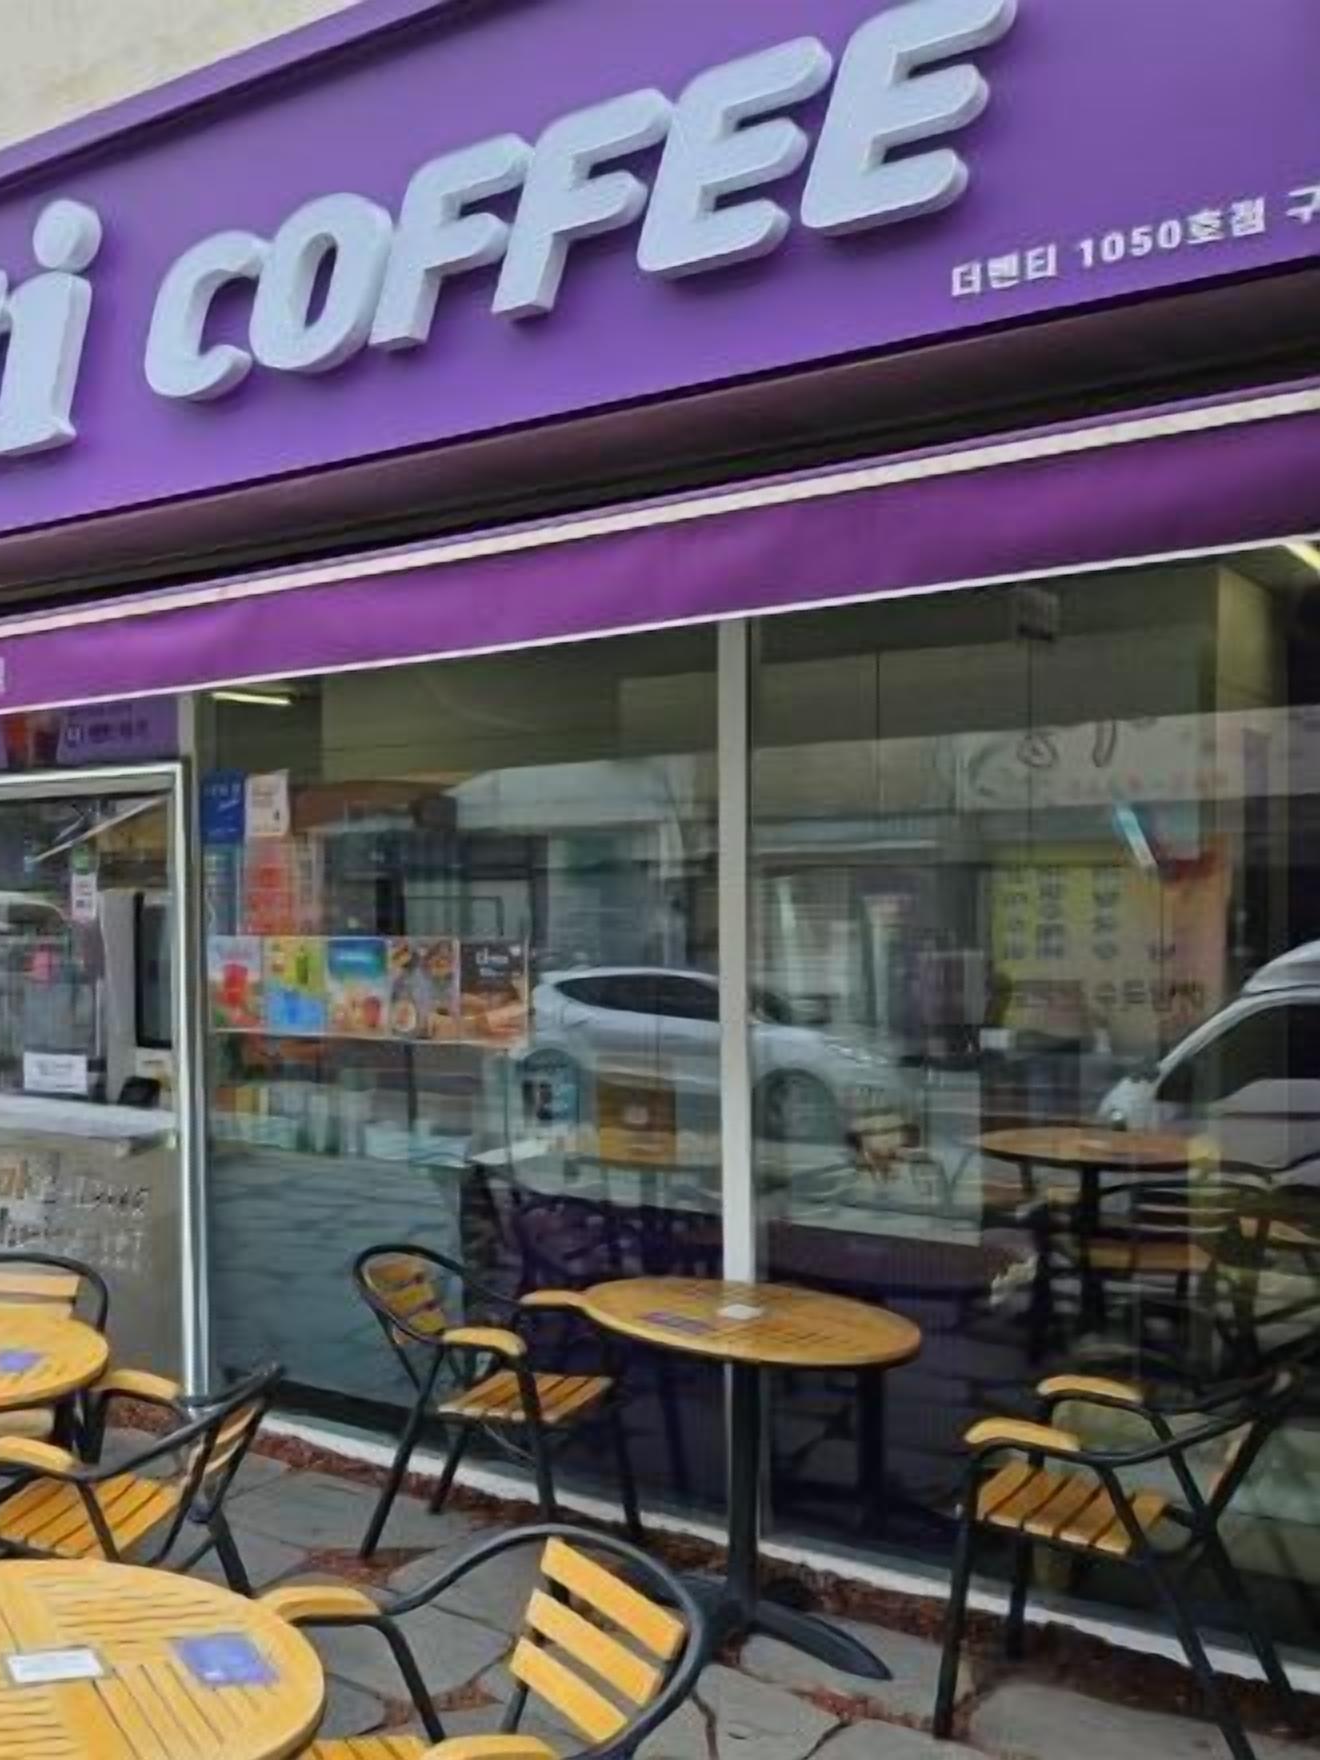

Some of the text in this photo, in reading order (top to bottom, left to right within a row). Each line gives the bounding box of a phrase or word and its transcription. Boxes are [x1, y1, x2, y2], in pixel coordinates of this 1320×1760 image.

[144, 0, 1016, 401] COFFEE
[951, 243, 1058, 297] 더벤티
[1079, 197, 1266, 269] 1050호점
